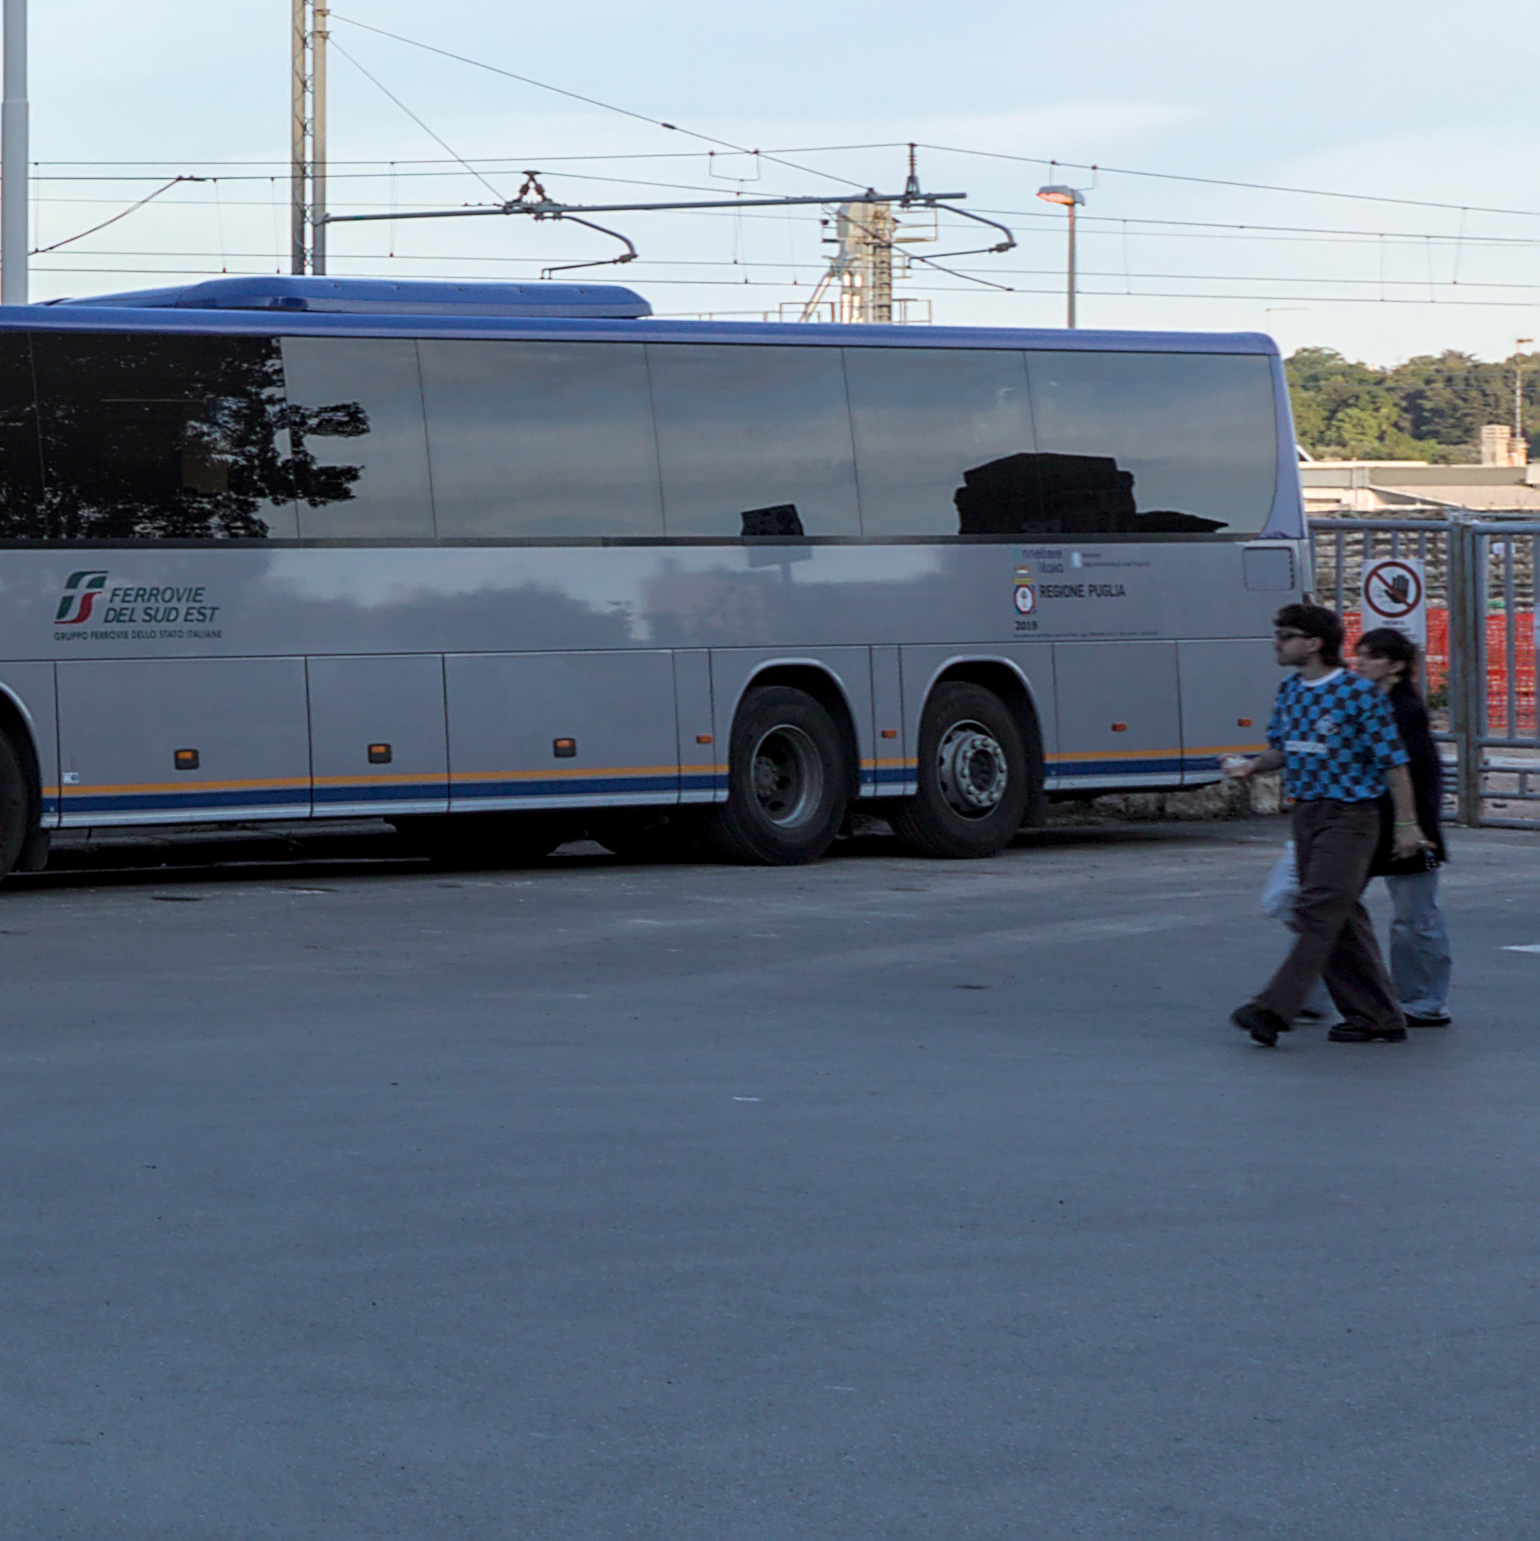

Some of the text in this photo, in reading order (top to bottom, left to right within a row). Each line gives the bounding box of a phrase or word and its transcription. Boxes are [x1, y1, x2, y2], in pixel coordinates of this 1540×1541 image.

[109, 587, 206, 603] FERROVIE
[1039, 584, 1126, 598] REGIONE PUGLIA
[103, 606, 220, 623] DEL SUD EST
[1015, 620, 1037, 630] 2019
[54, 631, 88, 641] GRUPPO
[90, 630, 129, 640] FERROVIE
[131, 630, 157, 639] DELLO
[159, 629, 184, 639] STATO
